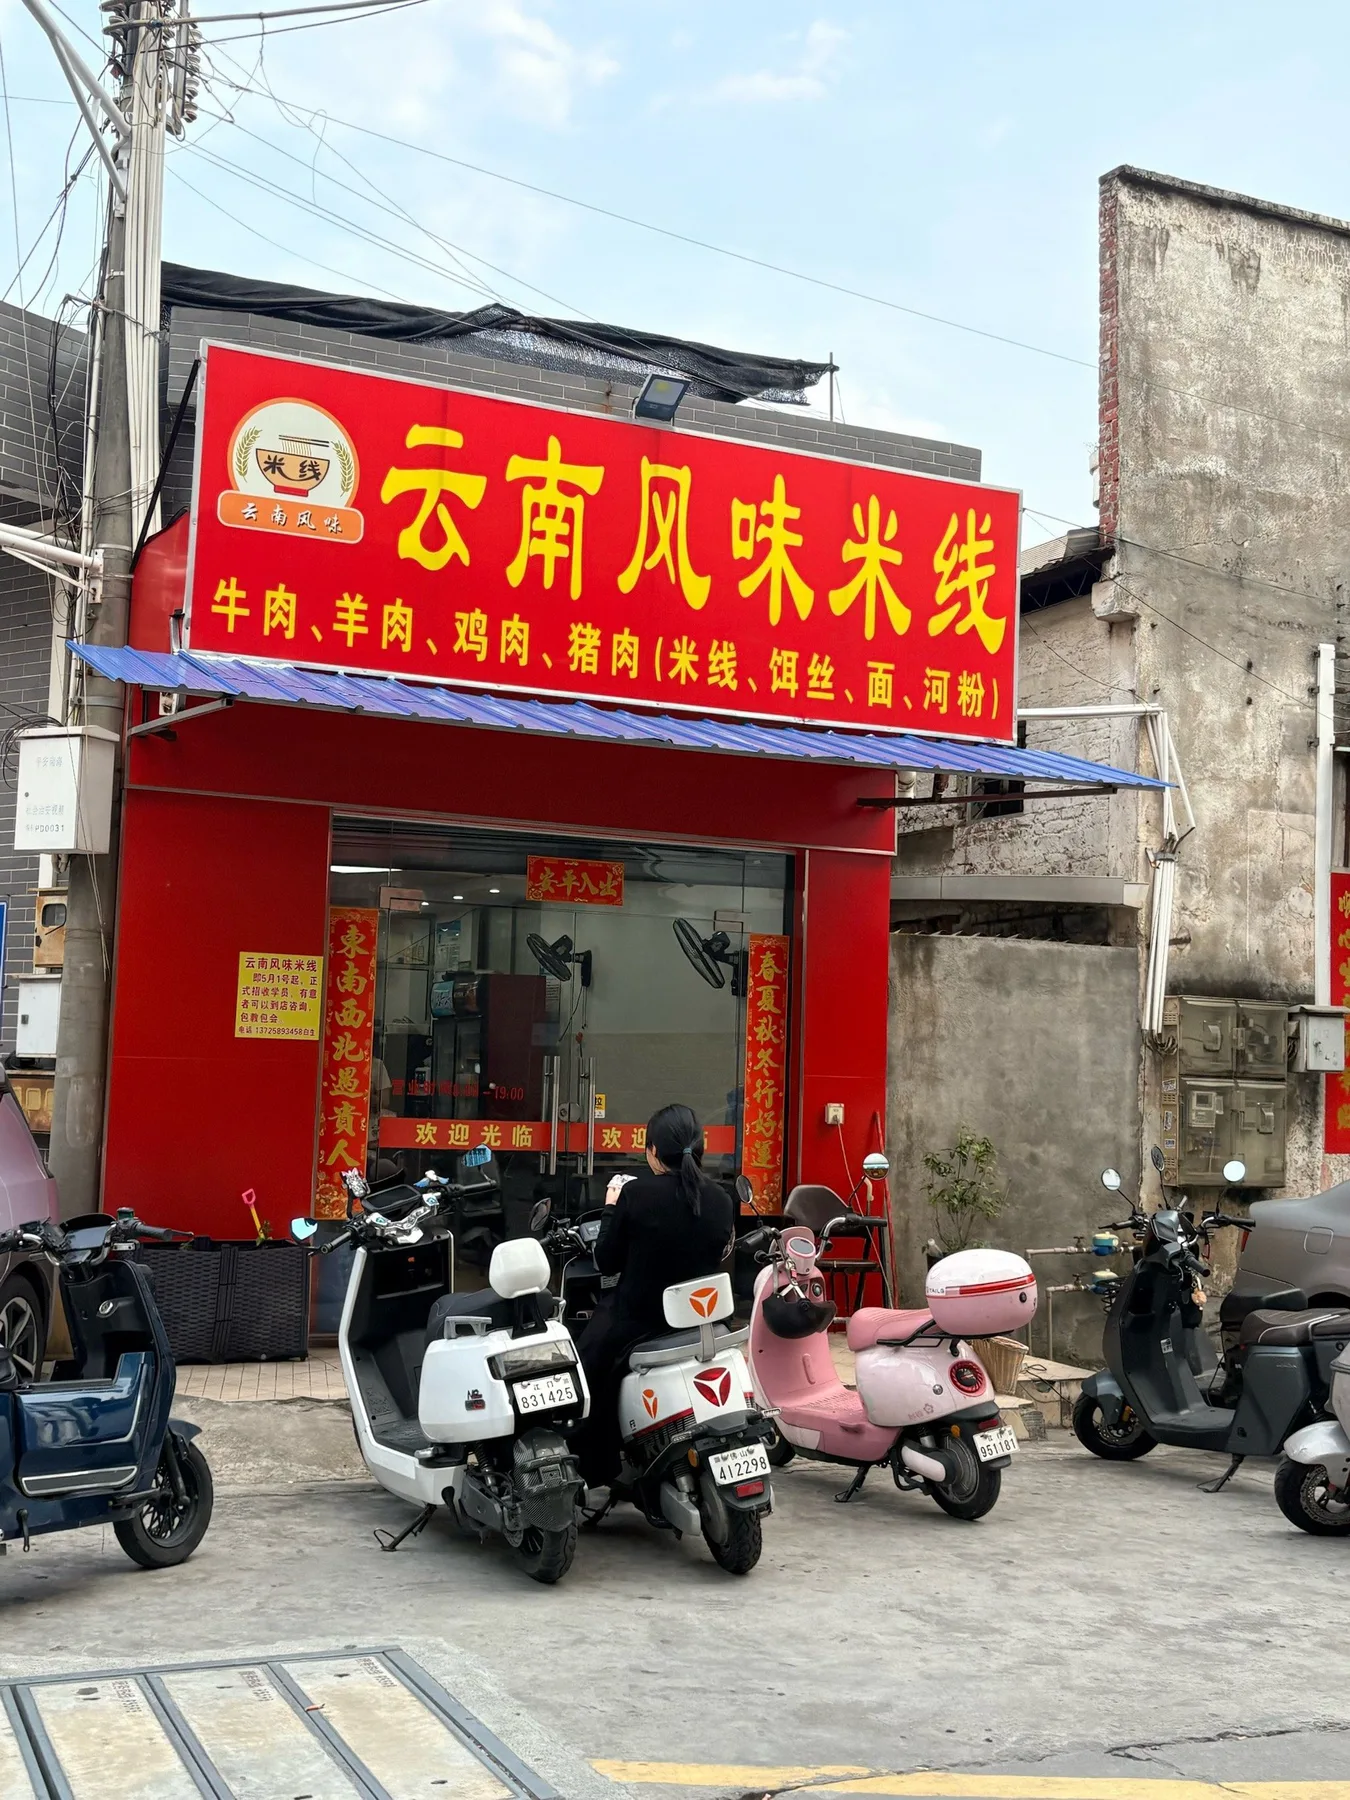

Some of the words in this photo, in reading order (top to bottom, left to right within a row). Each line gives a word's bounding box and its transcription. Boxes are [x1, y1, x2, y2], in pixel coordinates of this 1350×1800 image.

[263, 455, 321, 481] 米线
[241, 502, 343, 534] 云南风味
[381, 424, 1006, 655] 云南风味米线
[245, 957, 317, 972] 云南风味米线
[239, 1026, 252, 1034] 电话
[415, 1122, 533, 1147] 欢迎光临
[533, 1380, 554, 1391] 江门
[521, 1386, 574, 1409] 831425
[980, 1438, 1016, 1458] 951181
[719, 1456, 767, 1480] 412298
